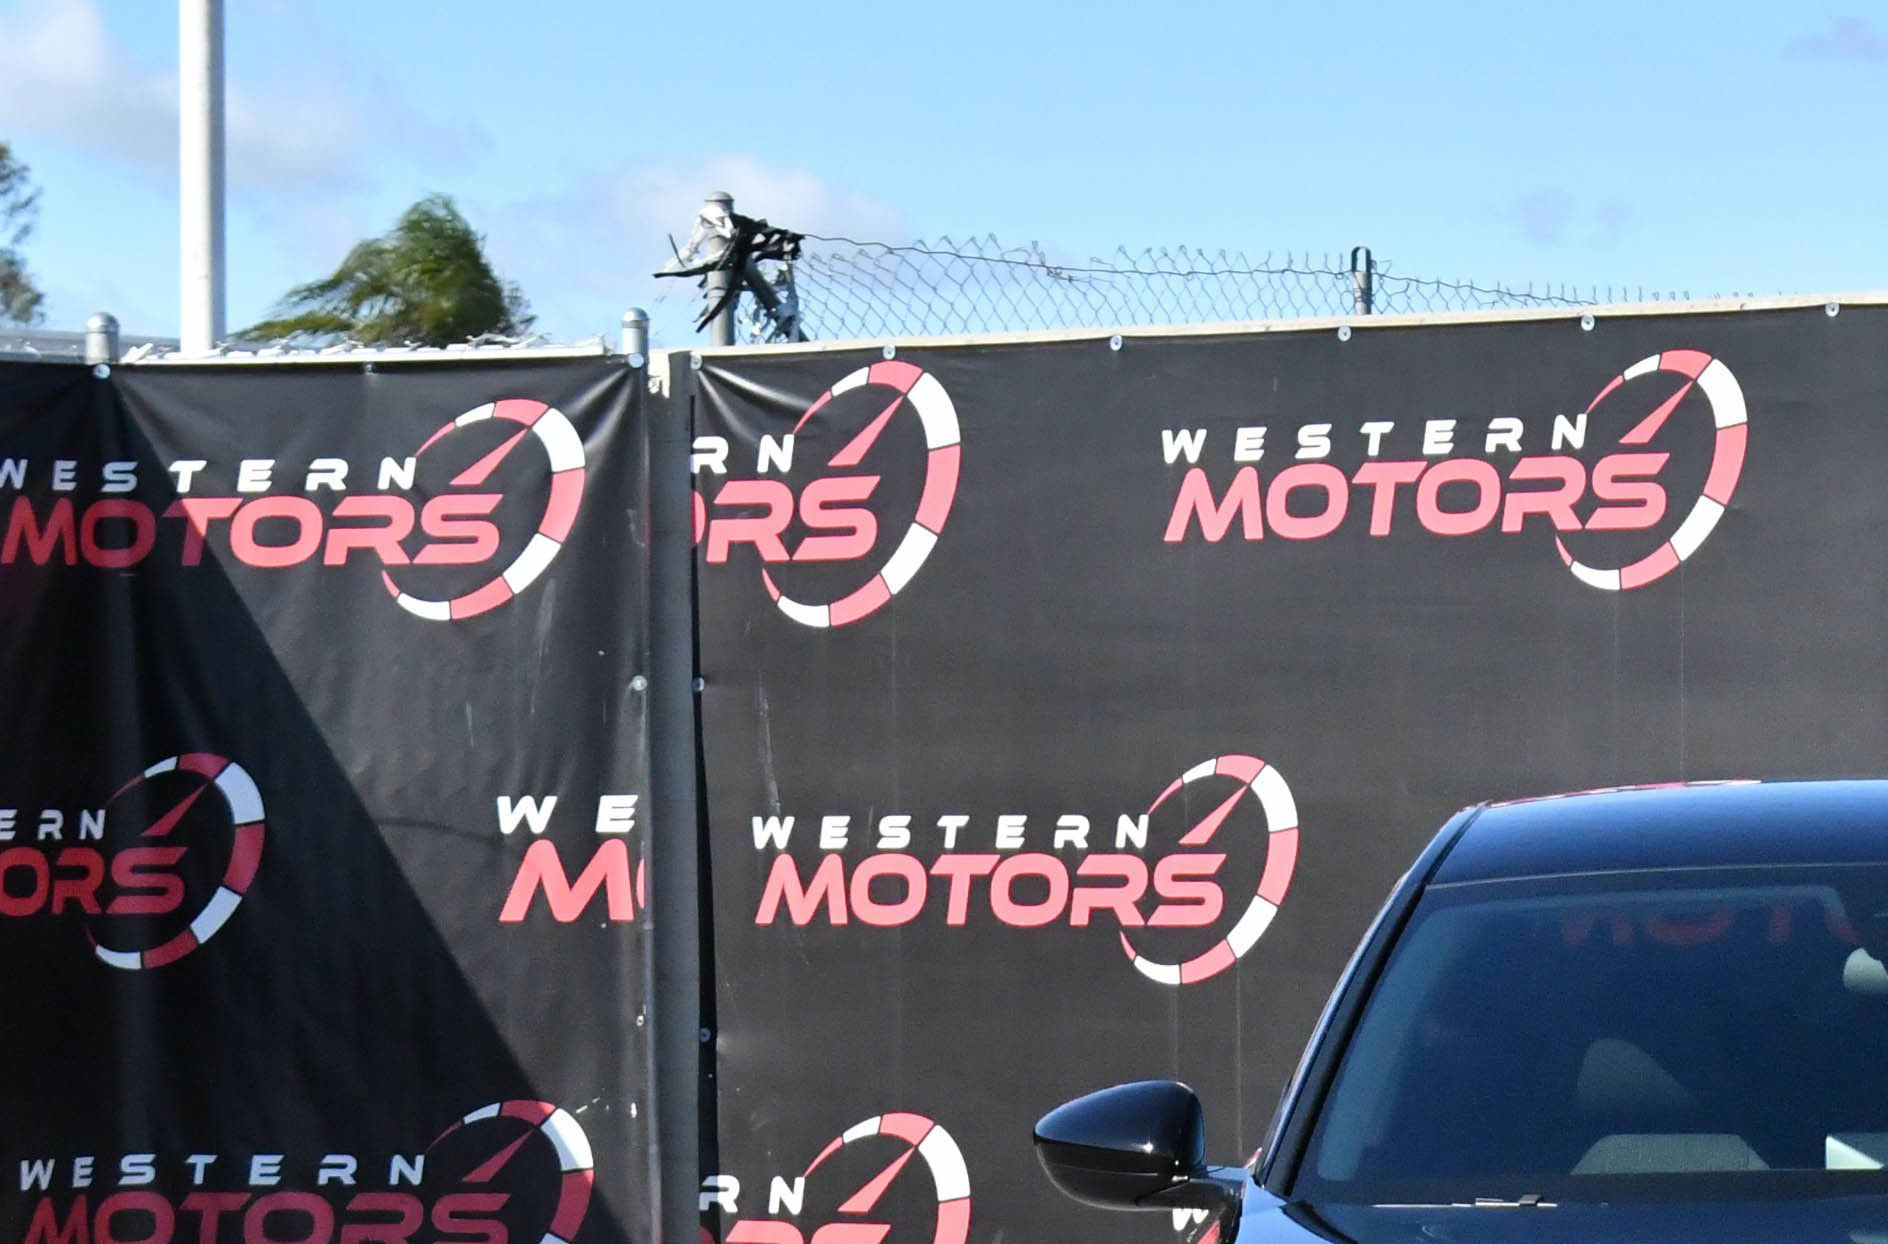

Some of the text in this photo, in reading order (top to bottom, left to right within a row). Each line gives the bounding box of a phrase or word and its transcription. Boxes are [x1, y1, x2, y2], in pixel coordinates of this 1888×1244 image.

[1161, 413, 1587, 464] WESTERN
[0, 457, 416, 493] WESTERN
[1163, 452, 1670, 542] MOTORS
[1, 494, 503, 568] MOTORS
[691, 475, 881, 563] RS
[752, 814, 1150, 849] WESTERN
[754, 852, 1226, 926] MOTORS
[19, 1153, 425, 1191] WESTERN
